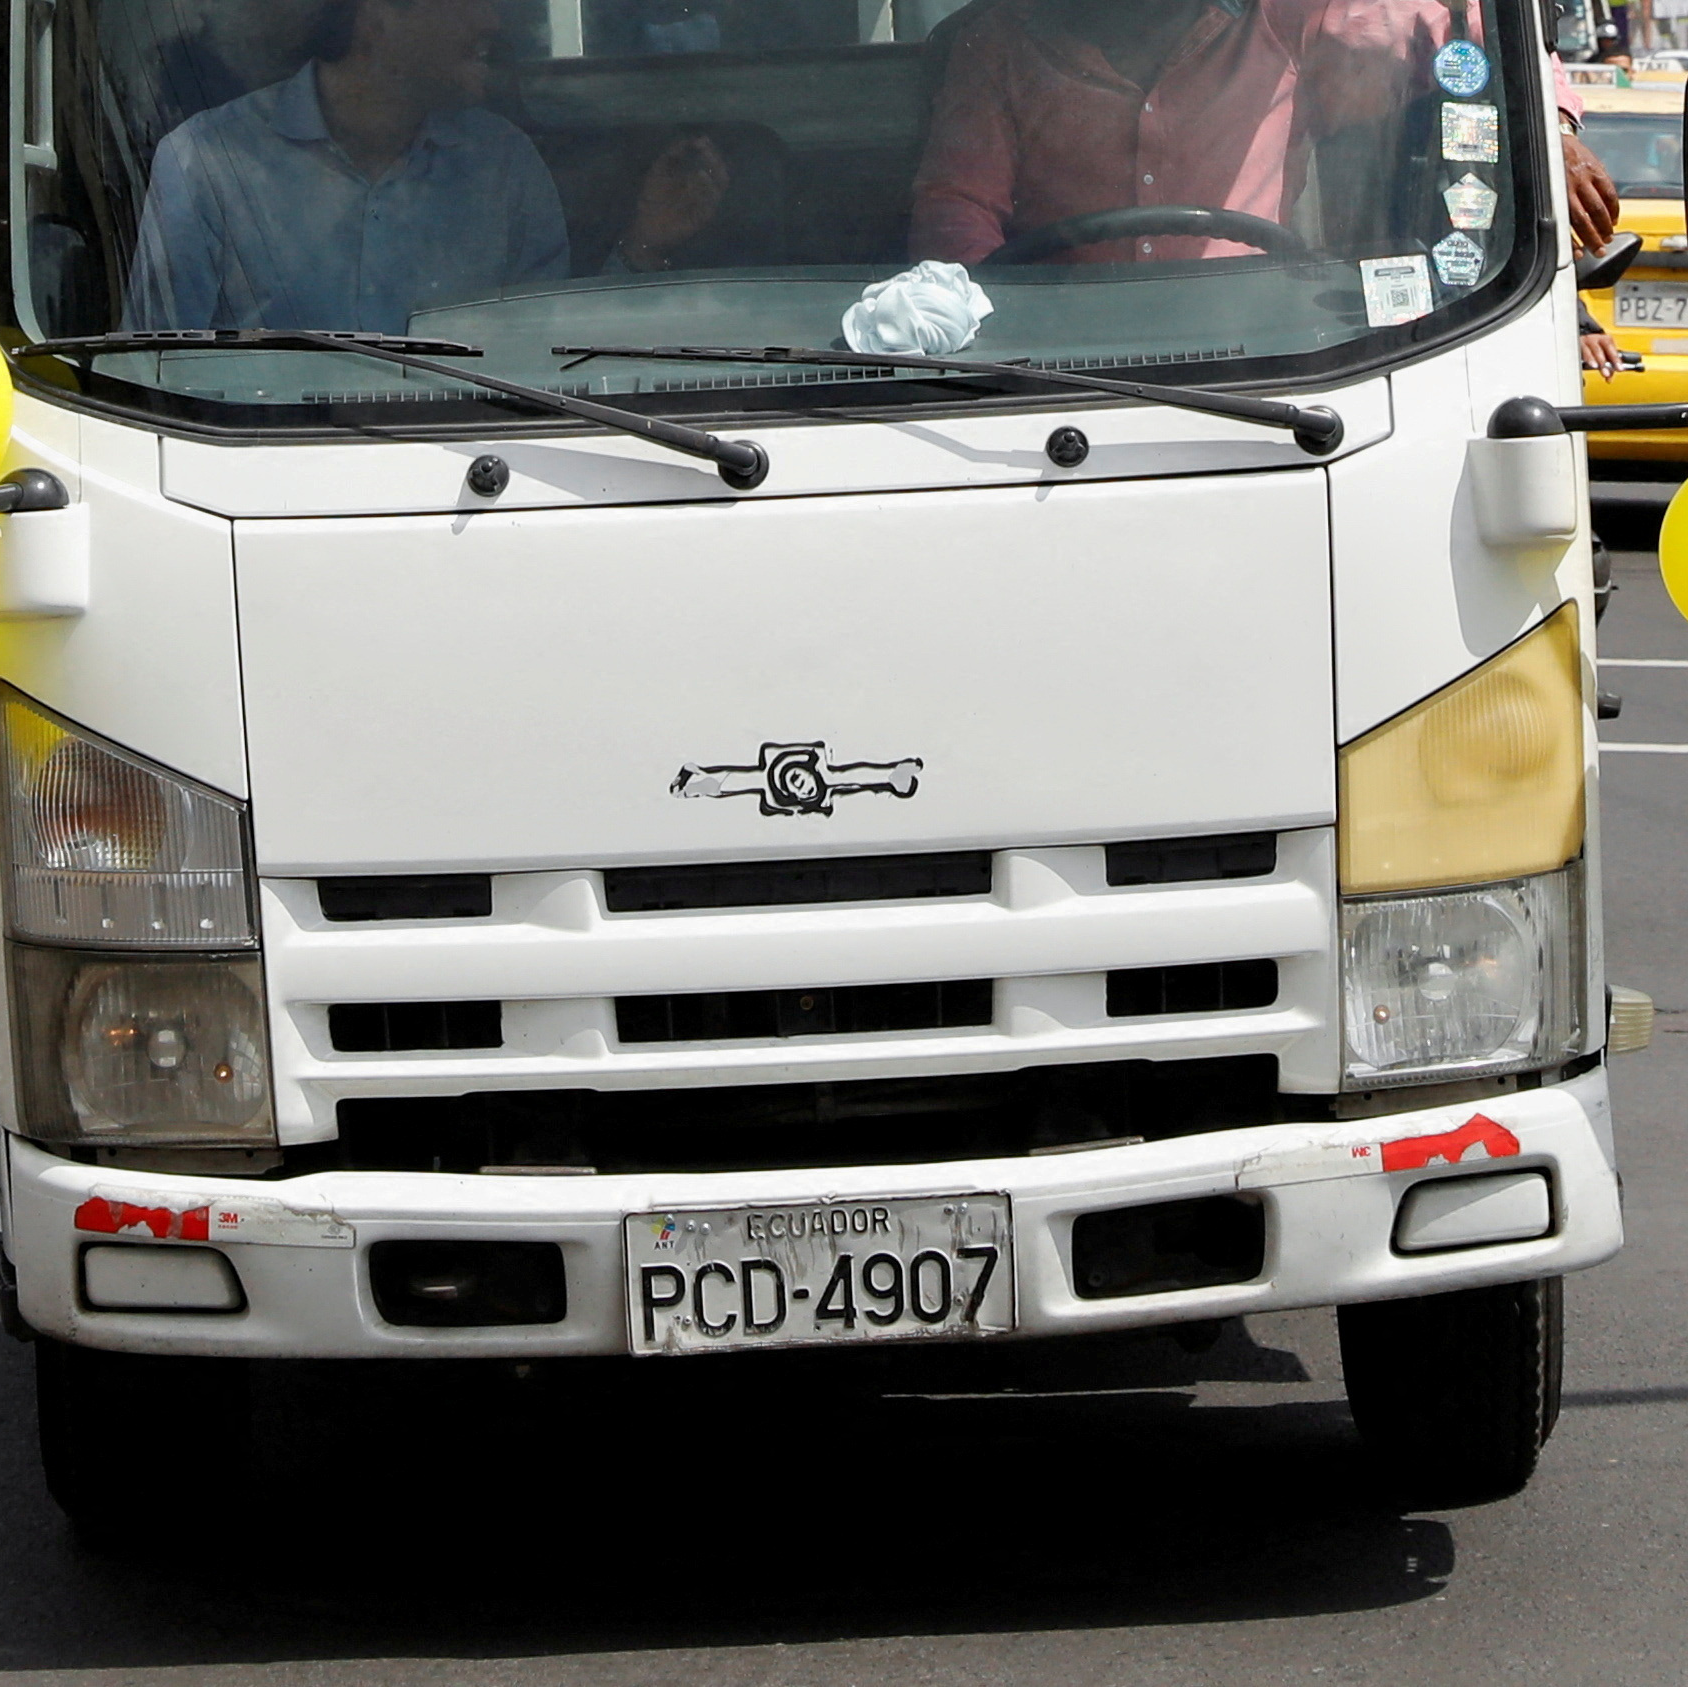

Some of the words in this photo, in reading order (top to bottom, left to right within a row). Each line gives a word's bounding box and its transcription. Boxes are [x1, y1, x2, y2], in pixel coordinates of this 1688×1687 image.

[218, 1213, 239, 1225] 3M
[746, 1206, 891, 1242] ECUADOR
[653, 1240, 676, 1251] ANT
[639, 1245, 1000, 1344] PCD-4907
